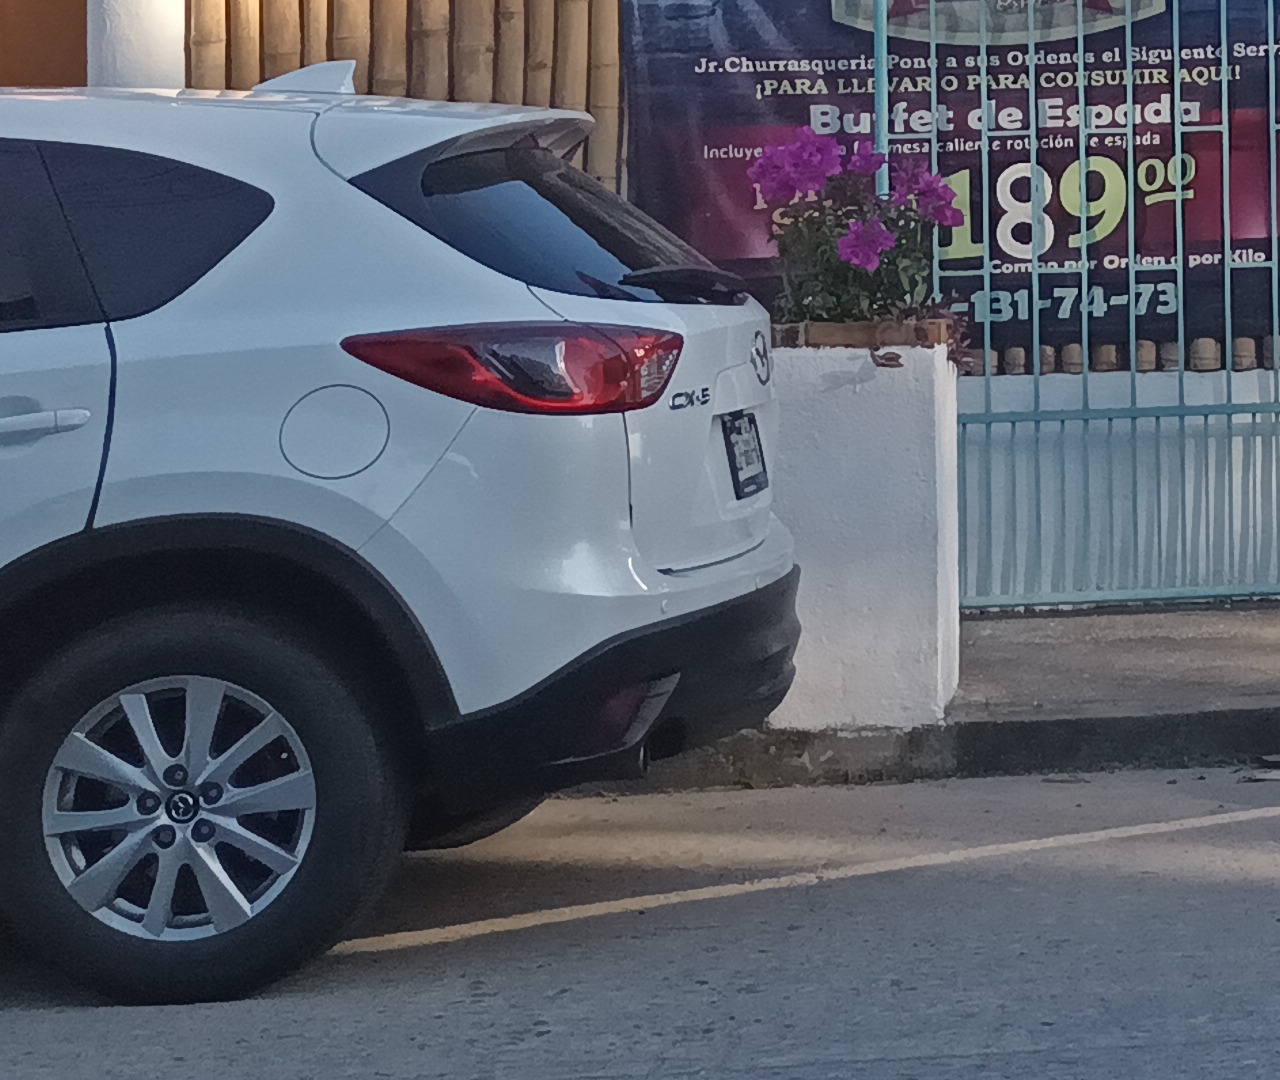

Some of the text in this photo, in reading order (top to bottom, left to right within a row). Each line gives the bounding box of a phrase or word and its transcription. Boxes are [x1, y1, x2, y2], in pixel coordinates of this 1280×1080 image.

[945, 56, 958, 68] a
[1101, 47, 1121, 62] el
[1131, 45, 1224, 64] Siguente
[940, 75, 958, 91] O
[809, 93, 1200, 135] Bufet de Espada
[936, 138, 1000, 153] caliene
[1006, 133, 1074, 150] rotción
[1188, 253, 1223, 268] por
